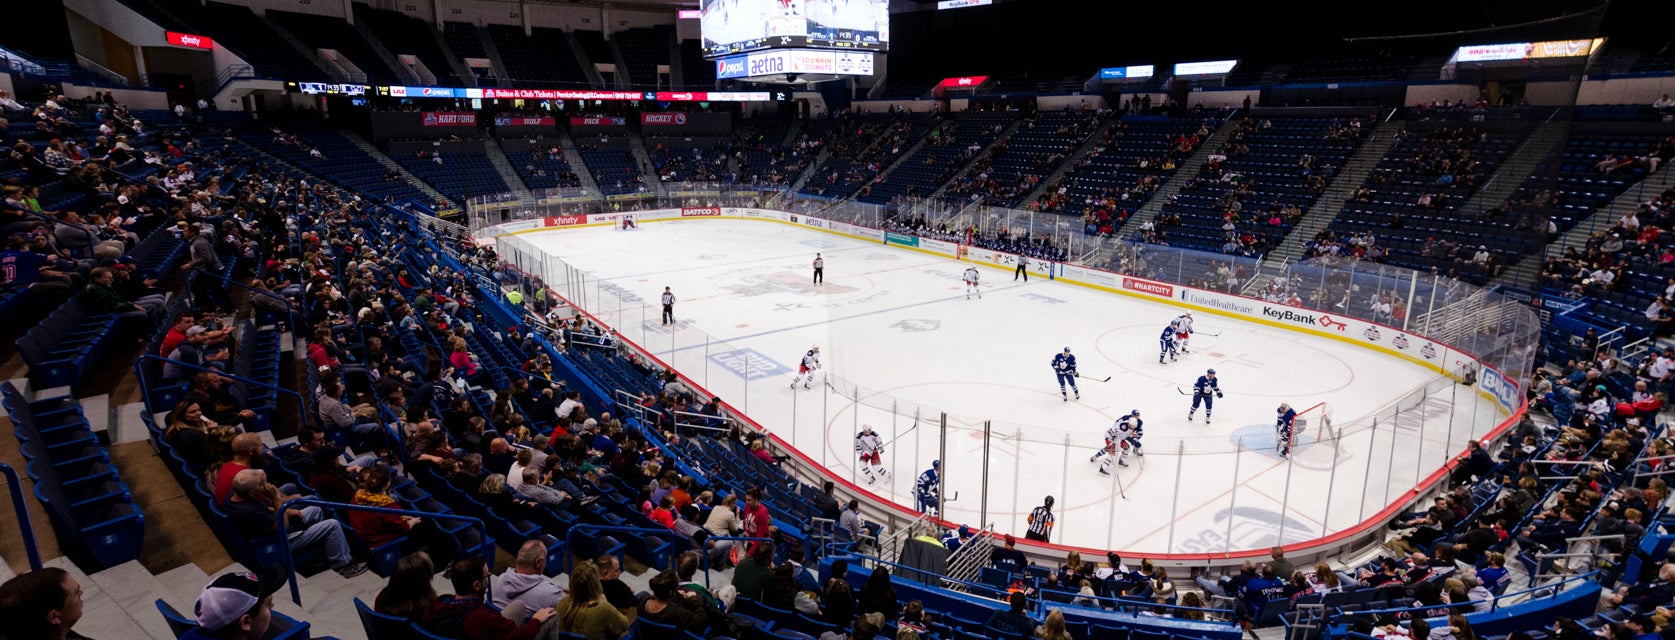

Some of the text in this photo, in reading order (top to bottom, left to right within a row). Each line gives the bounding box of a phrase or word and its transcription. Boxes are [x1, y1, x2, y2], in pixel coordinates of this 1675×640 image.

[726, 61, 744, 76] pepsi
[751, 55, 784, 74] aetna
[439, 114, 475, 123] HARTFORD
[646, 115, 672, 123] HOCKEY
[553, 216, 578, 226] xfinity
[805, 217, 822, 228] aetna
[1134, 282, 1170, 294] #HARTCITY
[1190, 294, 1253, 314] UnitedHealthcare
[1263, 306, 1316, 325] KeyBank
